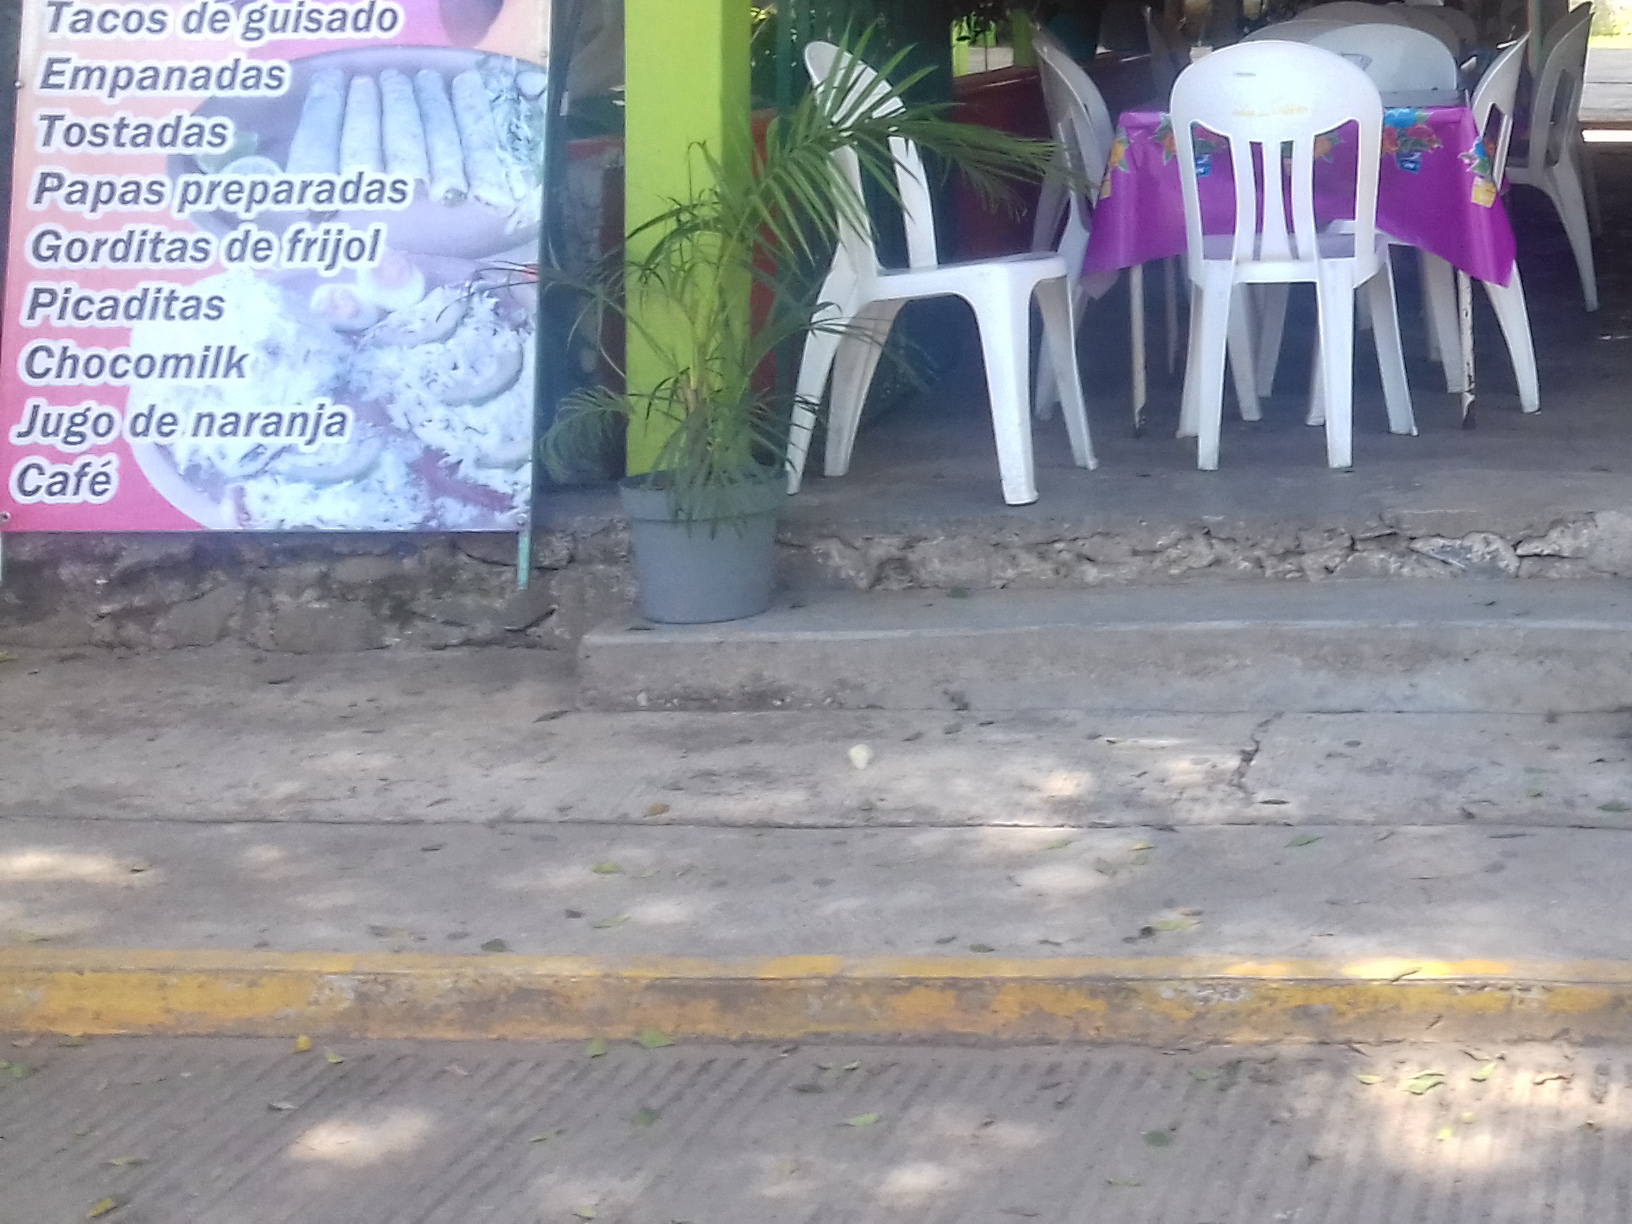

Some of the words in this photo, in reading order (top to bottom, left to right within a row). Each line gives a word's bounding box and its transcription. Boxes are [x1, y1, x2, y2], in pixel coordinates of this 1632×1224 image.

[45, 0, 168, 34] Tacos
[182, 1, 231, 34] de
[240, 0, 399, 40] guisado
[40, 57, 286, 98] Empanadas
[38, 114, 228, 148] Tostadas
[34, 172, 165, 213] Papas
[177, 171, 409, 213] preparadas
[31, 228, 212, 263] Gorditas
[224, 229, 274, 263] de
[285, 228, 381, 271] frijol
[26, 286, 226, 321] Picaditas
[24, 344, 250, 380] Chocomilk
[16, 404, 114, 446] Jugo
[130, 404, 178, 439] de
[191, 404, 348, 447] naranja
[16, 461, 112, 498] Café
